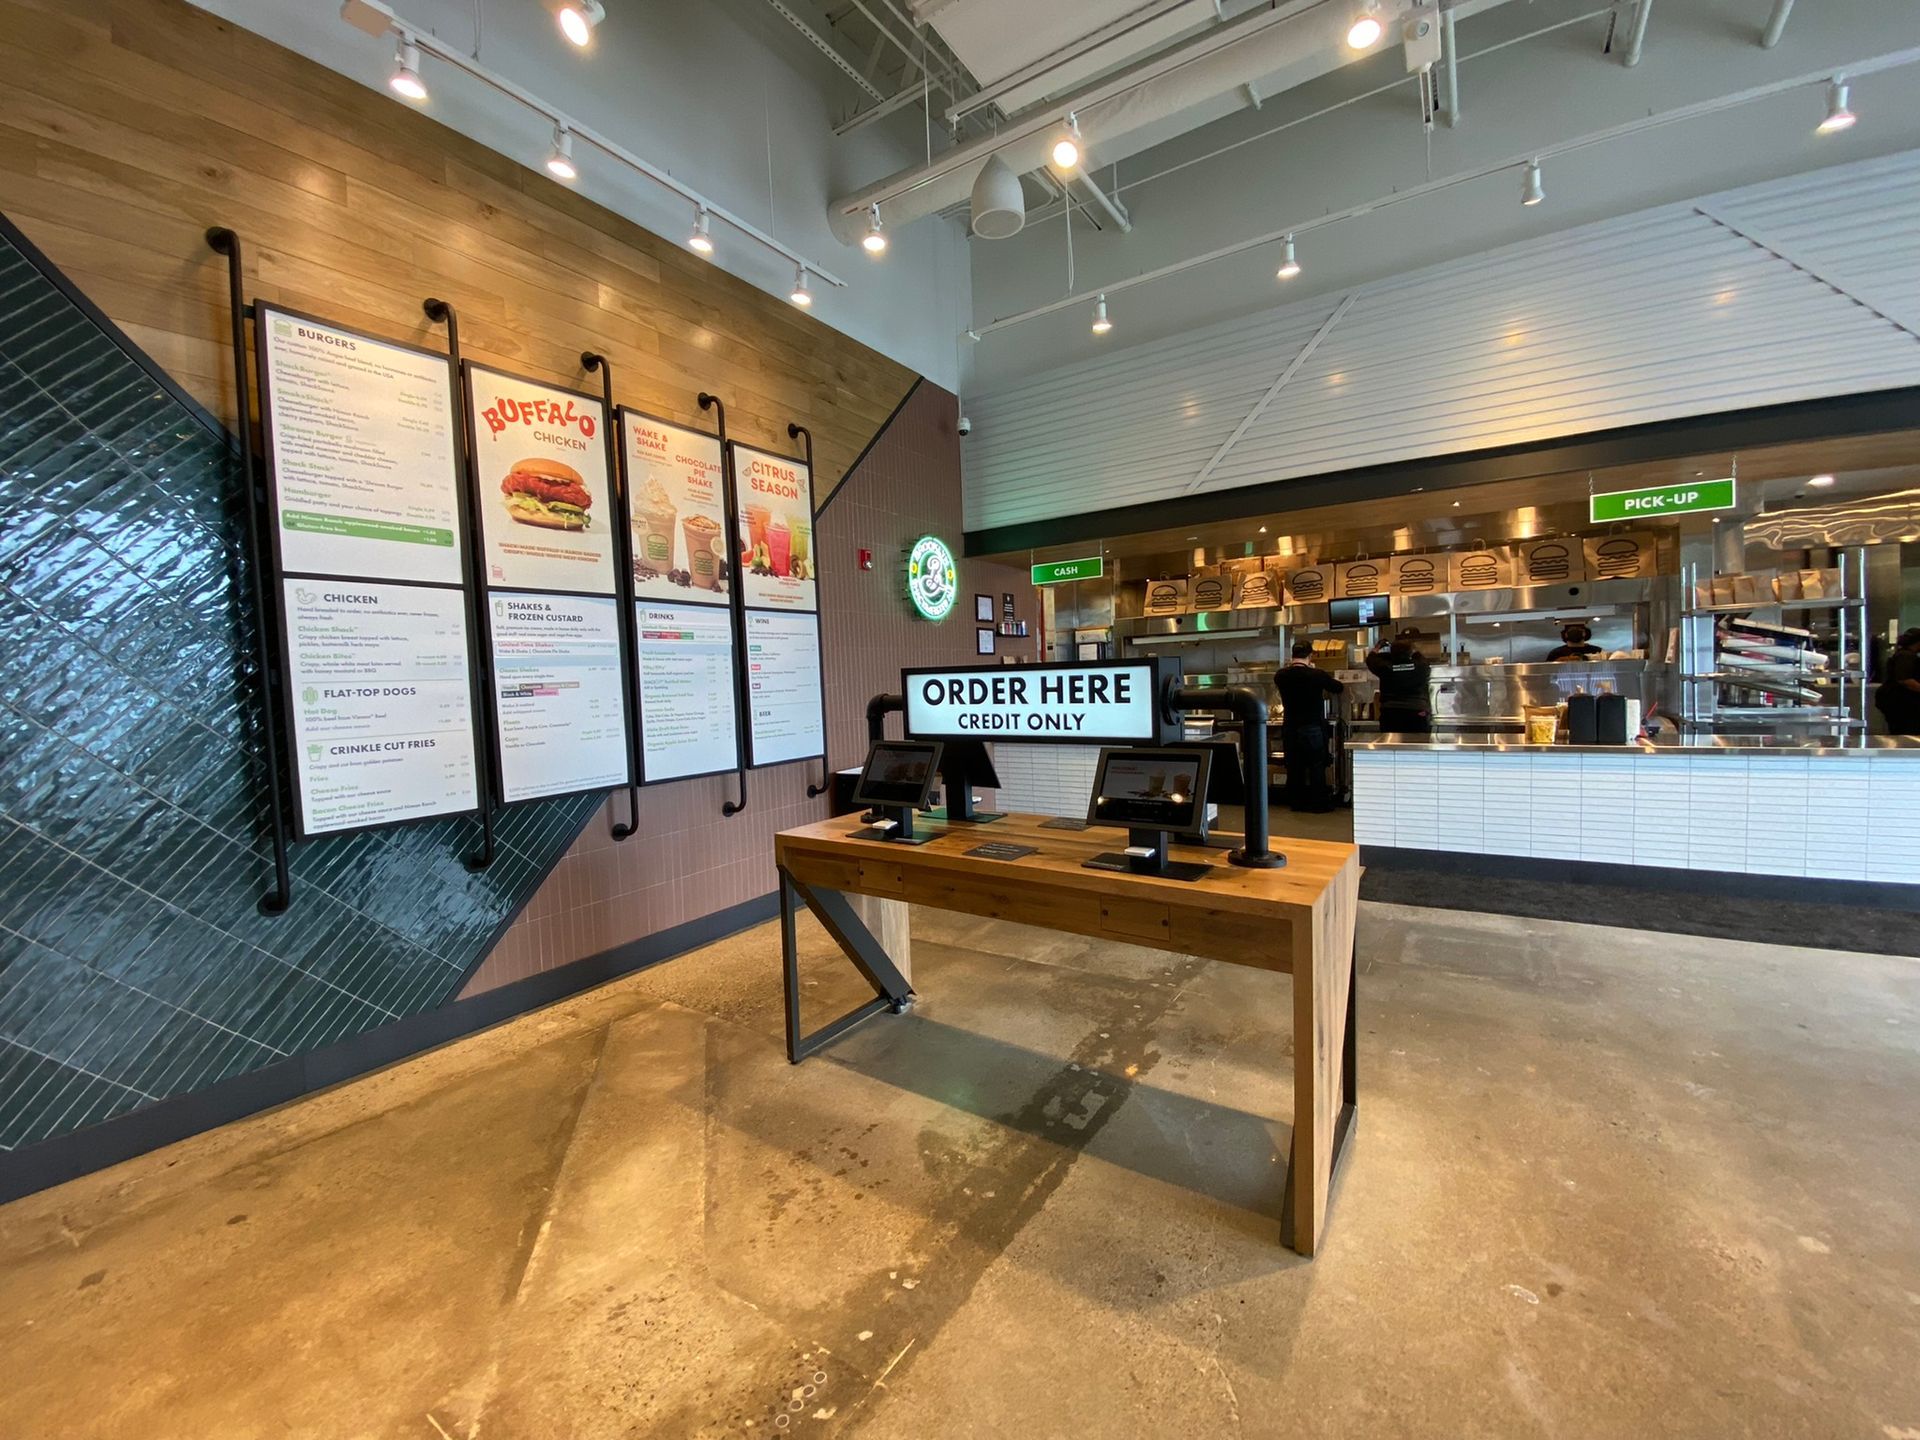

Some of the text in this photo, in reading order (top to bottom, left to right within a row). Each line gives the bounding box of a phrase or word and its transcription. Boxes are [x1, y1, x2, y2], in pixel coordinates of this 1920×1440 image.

[298, 327, 356, 351] BURGERS
[481, 398, 595, 438] BUFFALO
[534, 430, 586, 451] CHICKEN
[633, 426, 668, 443] WAKE &
[636, 436, 666, 452] SHAKE
[675, 454, 721, 473] CHOCOLATE
[751, 461, 796, 483] CITRUS
[694, 468, 705, 478] PIE
[688, 476, 713, 489] SHAKE
[751, 477, 798, 499] SEASON
[1624, 491, 1699, 510] PICK-UP
[1054, 566, 1078, 576] CASH
[324, 594, 378, 604] CHICKEN
[507, 602, 543, 610] SHAKES
[508, 613, 583, 622] FROZEN CUSTARD
[324, 688, 416, 698] FLAT-TOP DOGS
[922, 674, 1131, 706] ORDER HERE
[958, 713, 1086, 730] CREDIT ONLY
[330, 740, 435, 755] CRINKLE CUT FRIES
